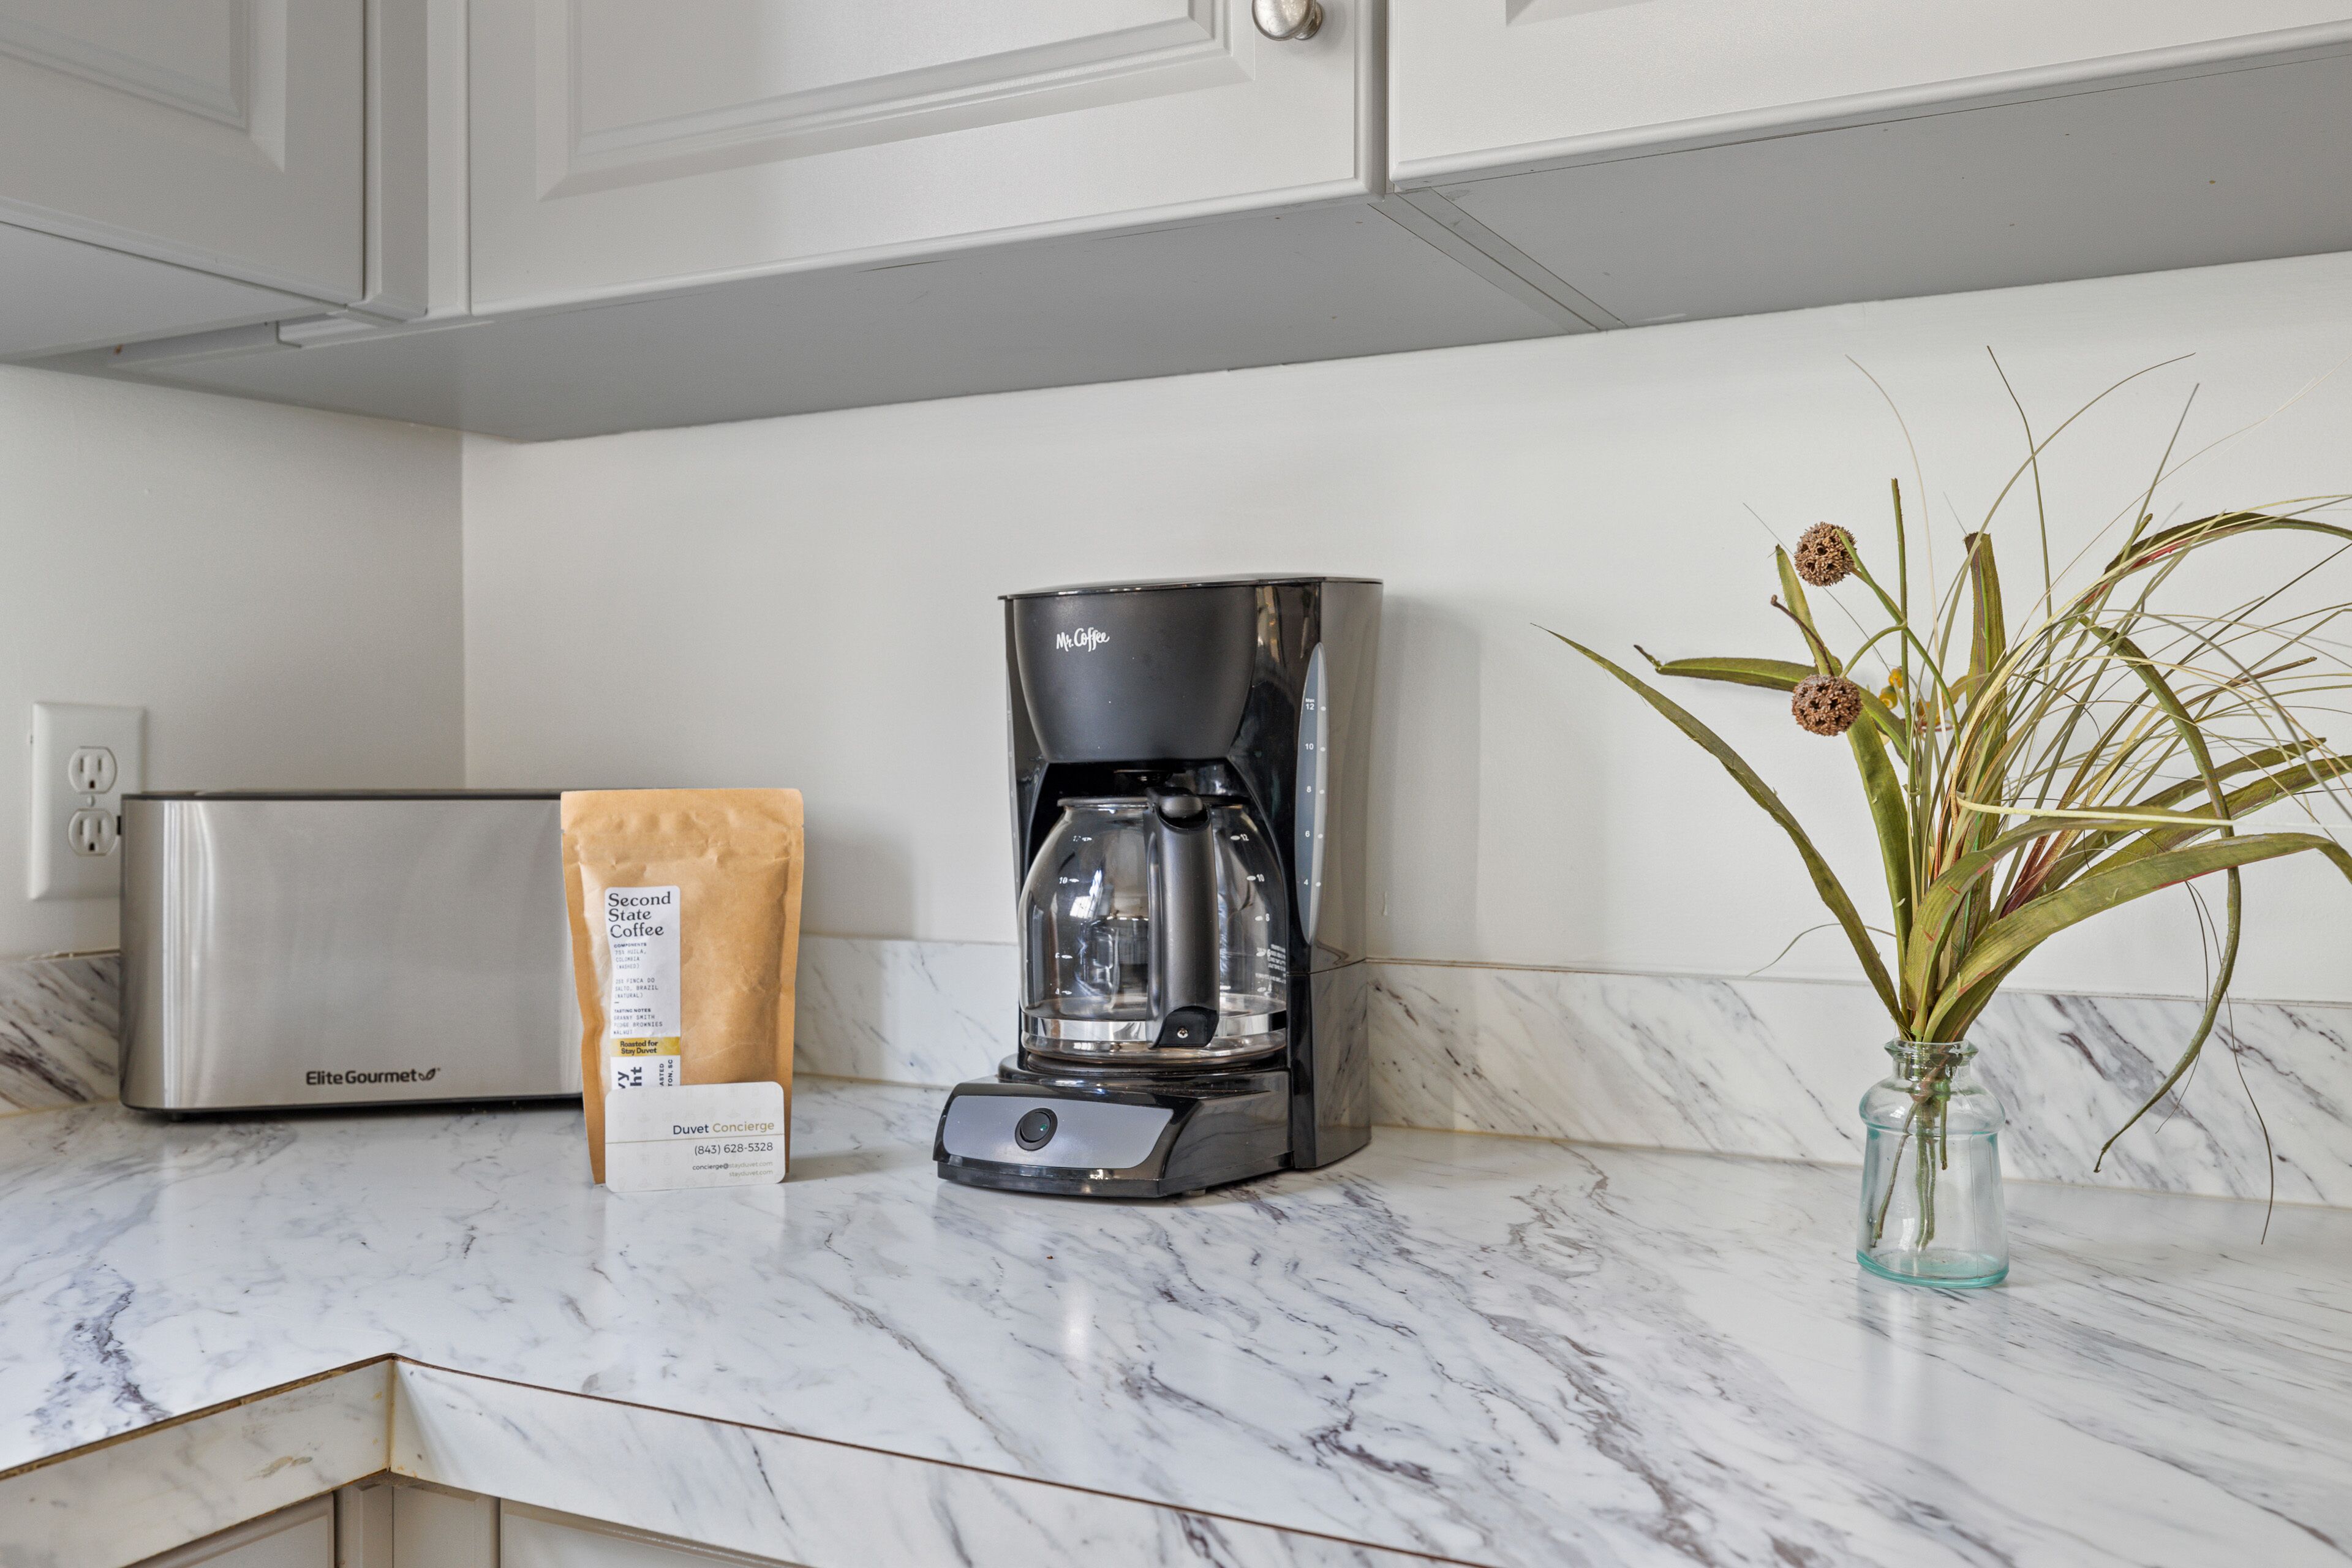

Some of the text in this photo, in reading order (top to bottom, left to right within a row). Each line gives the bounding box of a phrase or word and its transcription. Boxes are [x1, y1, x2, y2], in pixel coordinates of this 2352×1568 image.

[1056, 627, 1110, 652] Mr. Coffee
[608, 891, 671, 907] Second
[608, 908, 652, 922] State
[1265, 913, 1270, 922] 8
[610, 922, 665, 938] Coffee
[668, 1059, 673, 1068] SC
[306, 1069, 417, 1085] Elite Gourmet
[673, 1121, 775, 1134] Duvet Concierge
[695, 1142, 774, 1156] (843) 628-5328
[692, 1161, 774, 1170] concierge@stayduvet.com
